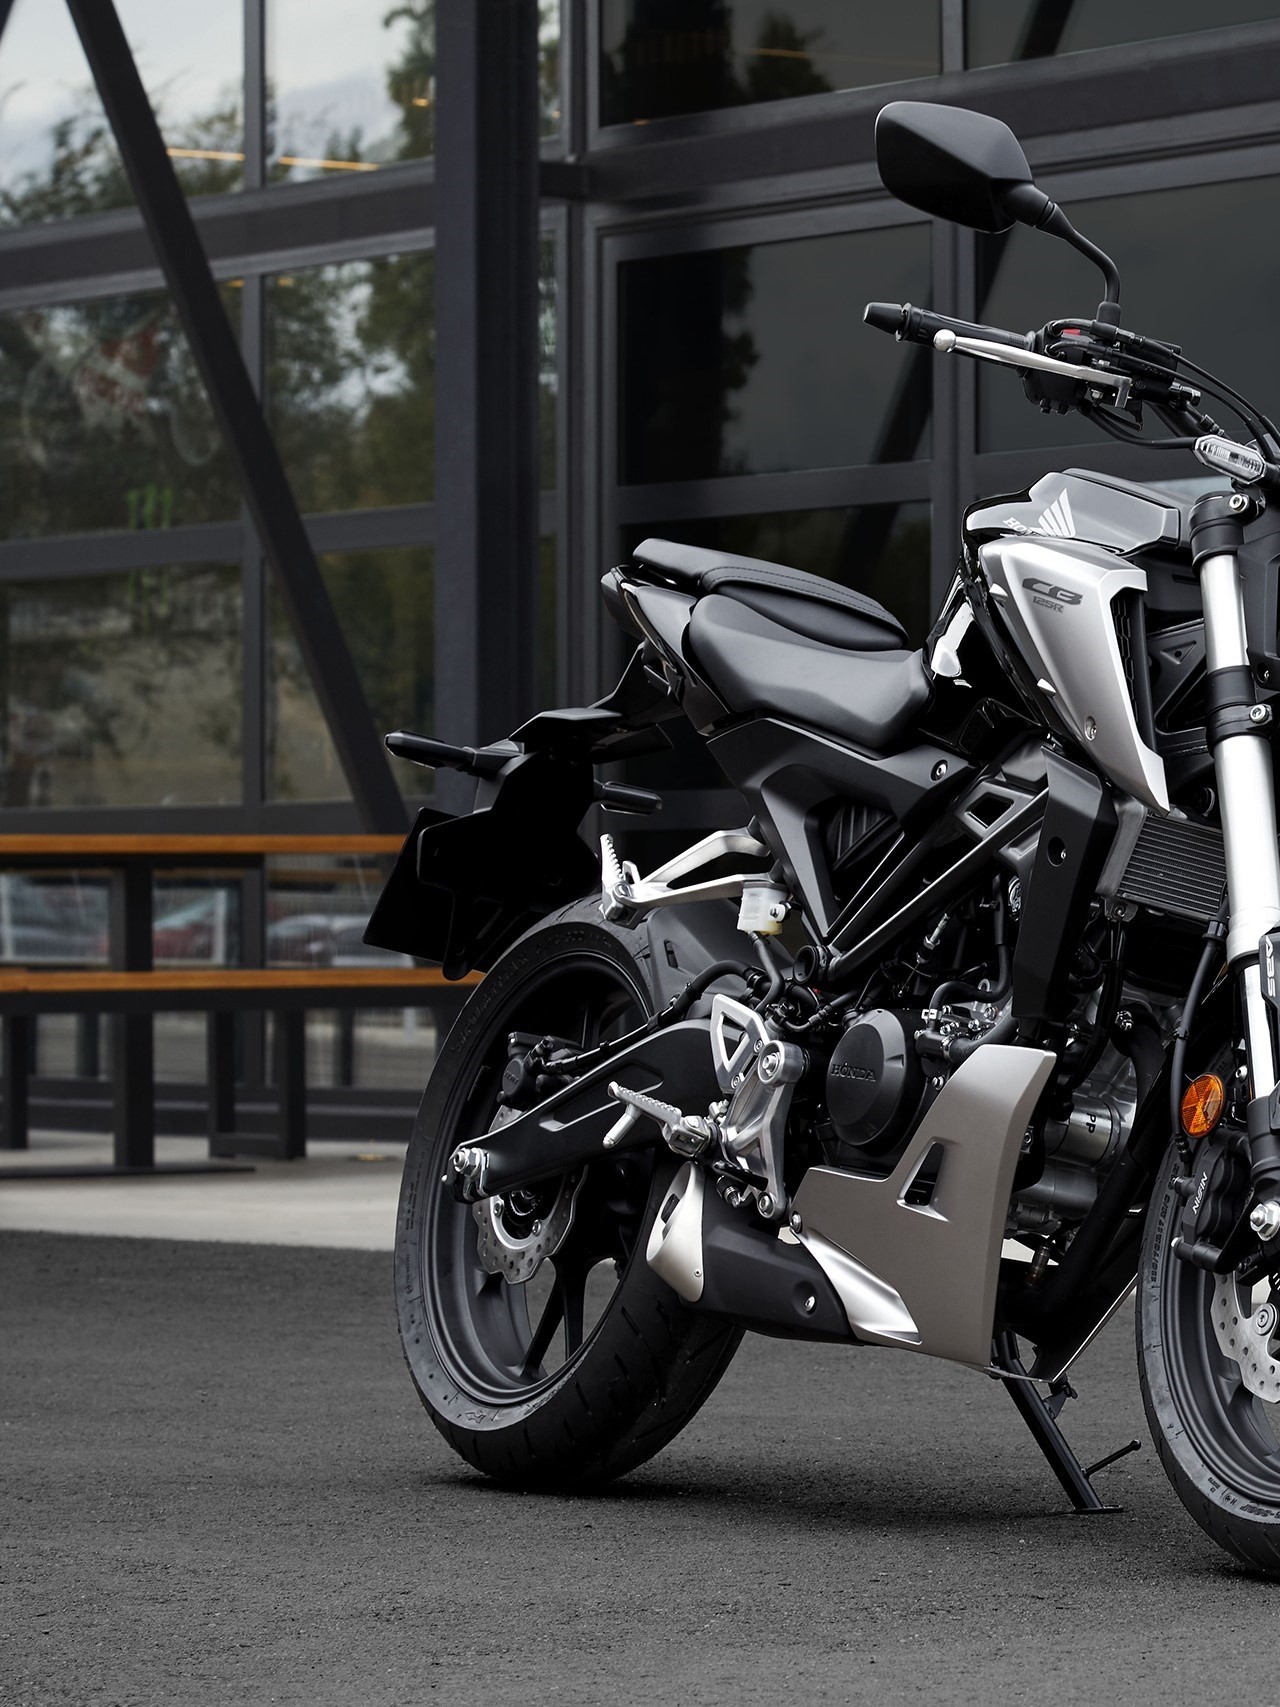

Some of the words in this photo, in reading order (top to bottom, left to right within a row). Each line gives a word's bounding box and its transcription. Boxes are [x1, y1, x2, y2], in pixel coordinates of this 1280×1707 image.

[1022, 578, 1083, 605] CB
[1265, 935, 1276, 997] ABS
[830, 1063, 876, 1082] HONDA
[1192, 1171, 1208, 1215] NISSIN
